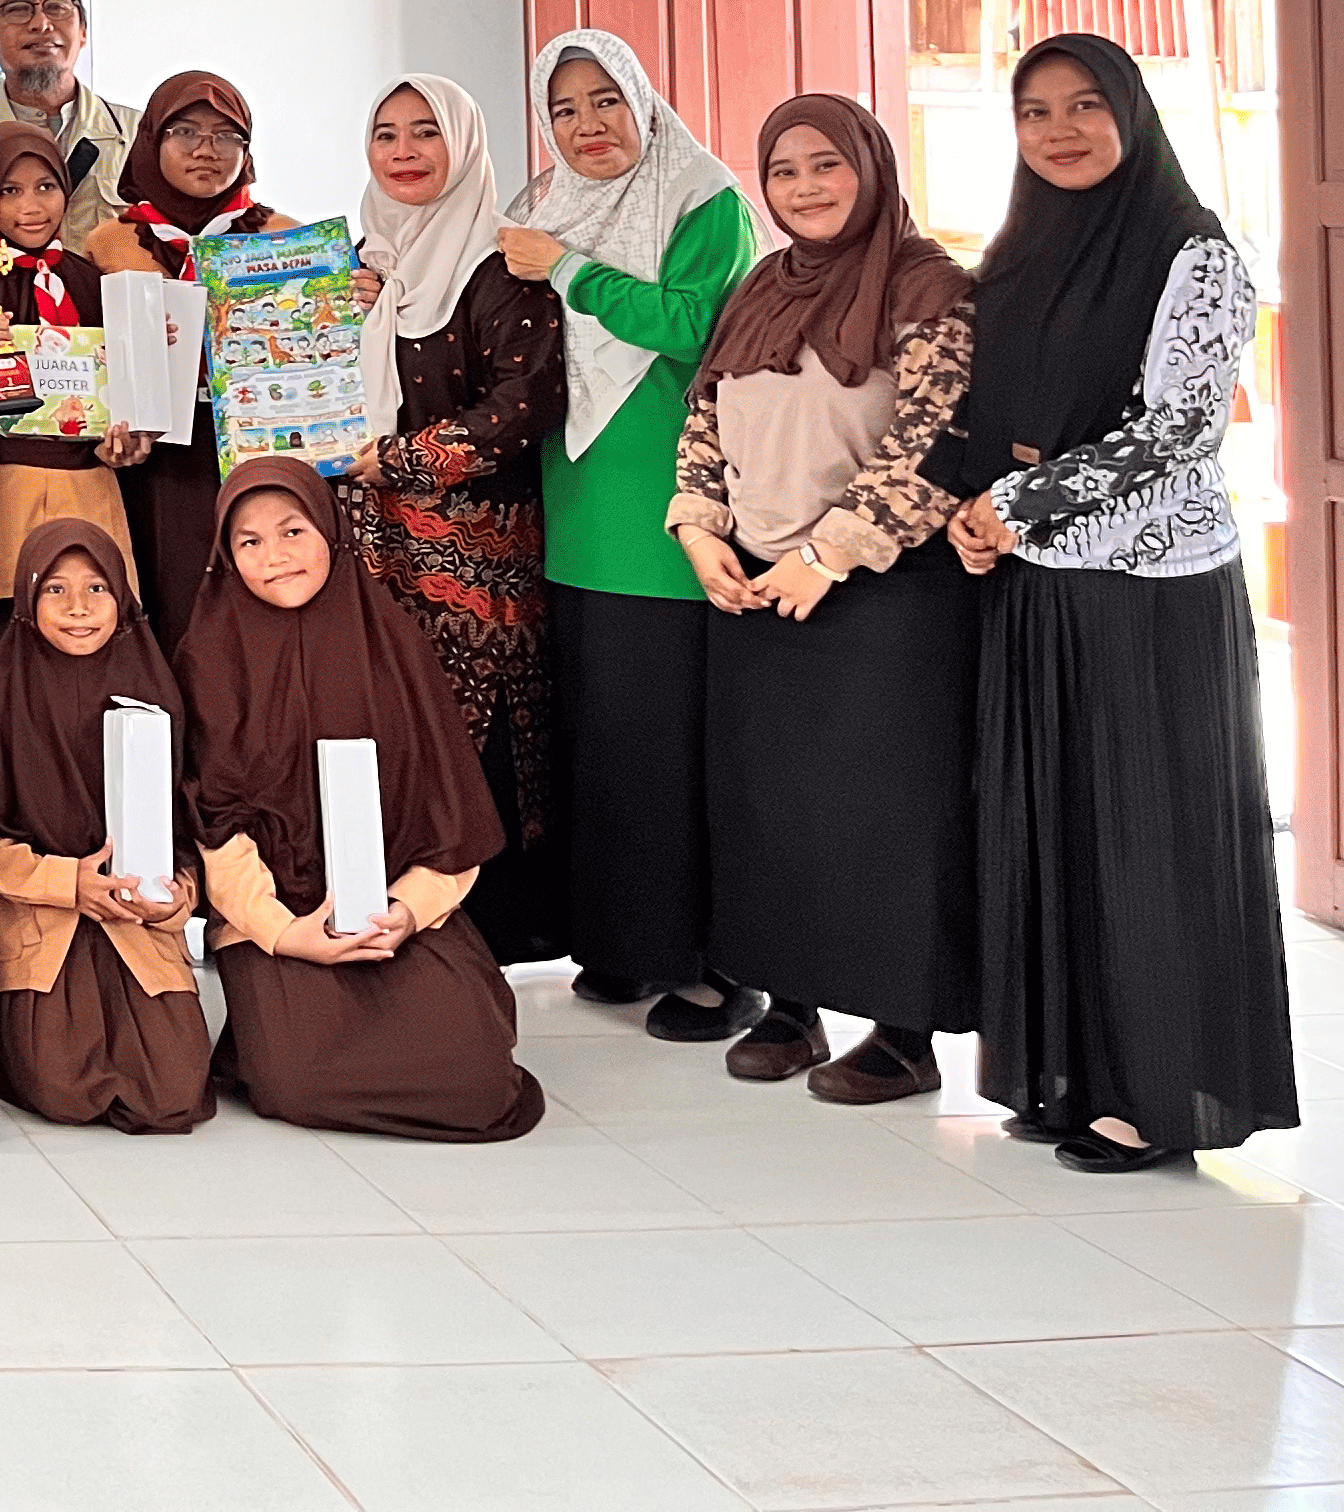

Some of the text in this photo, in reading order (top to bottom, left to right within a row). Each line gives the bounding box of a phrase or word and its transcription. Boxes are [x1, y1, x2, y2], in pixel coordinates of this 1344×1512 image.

[247, 262, 279, 274] MASA
[35, 359, 90, 372] JUARA 1
[6, 377, 15, 386] 1
[39, 379, 89, 391] POSTER
